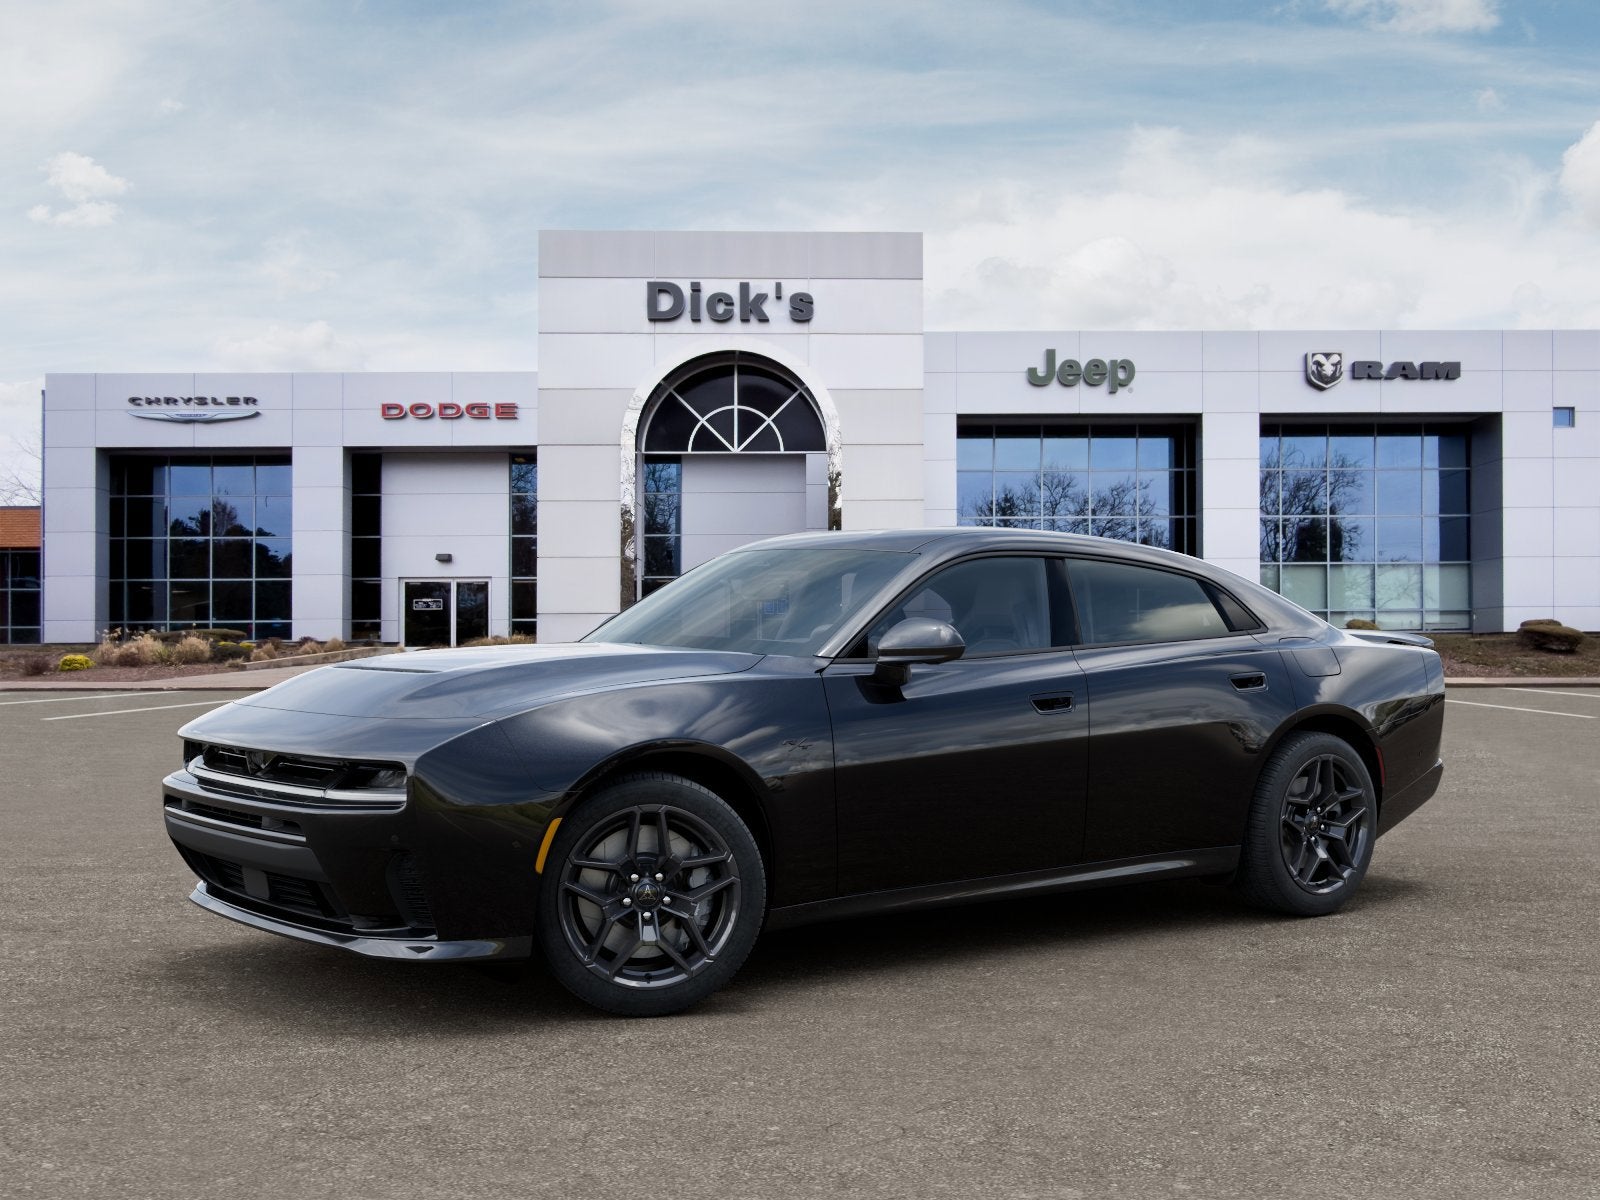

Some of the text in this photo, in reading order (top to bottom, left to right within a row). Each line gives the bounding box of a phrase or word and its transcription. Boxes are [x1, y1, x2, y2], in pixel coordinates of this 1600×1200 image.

[647, 281, 814, 322] Dick's
[1027, 348, 1136, 395] Jeep
[1351, 360, 1461, 380] RAM
[127, 396, 258, 407] CHRYSLER
[381, 402, 519, 420] DODGE
